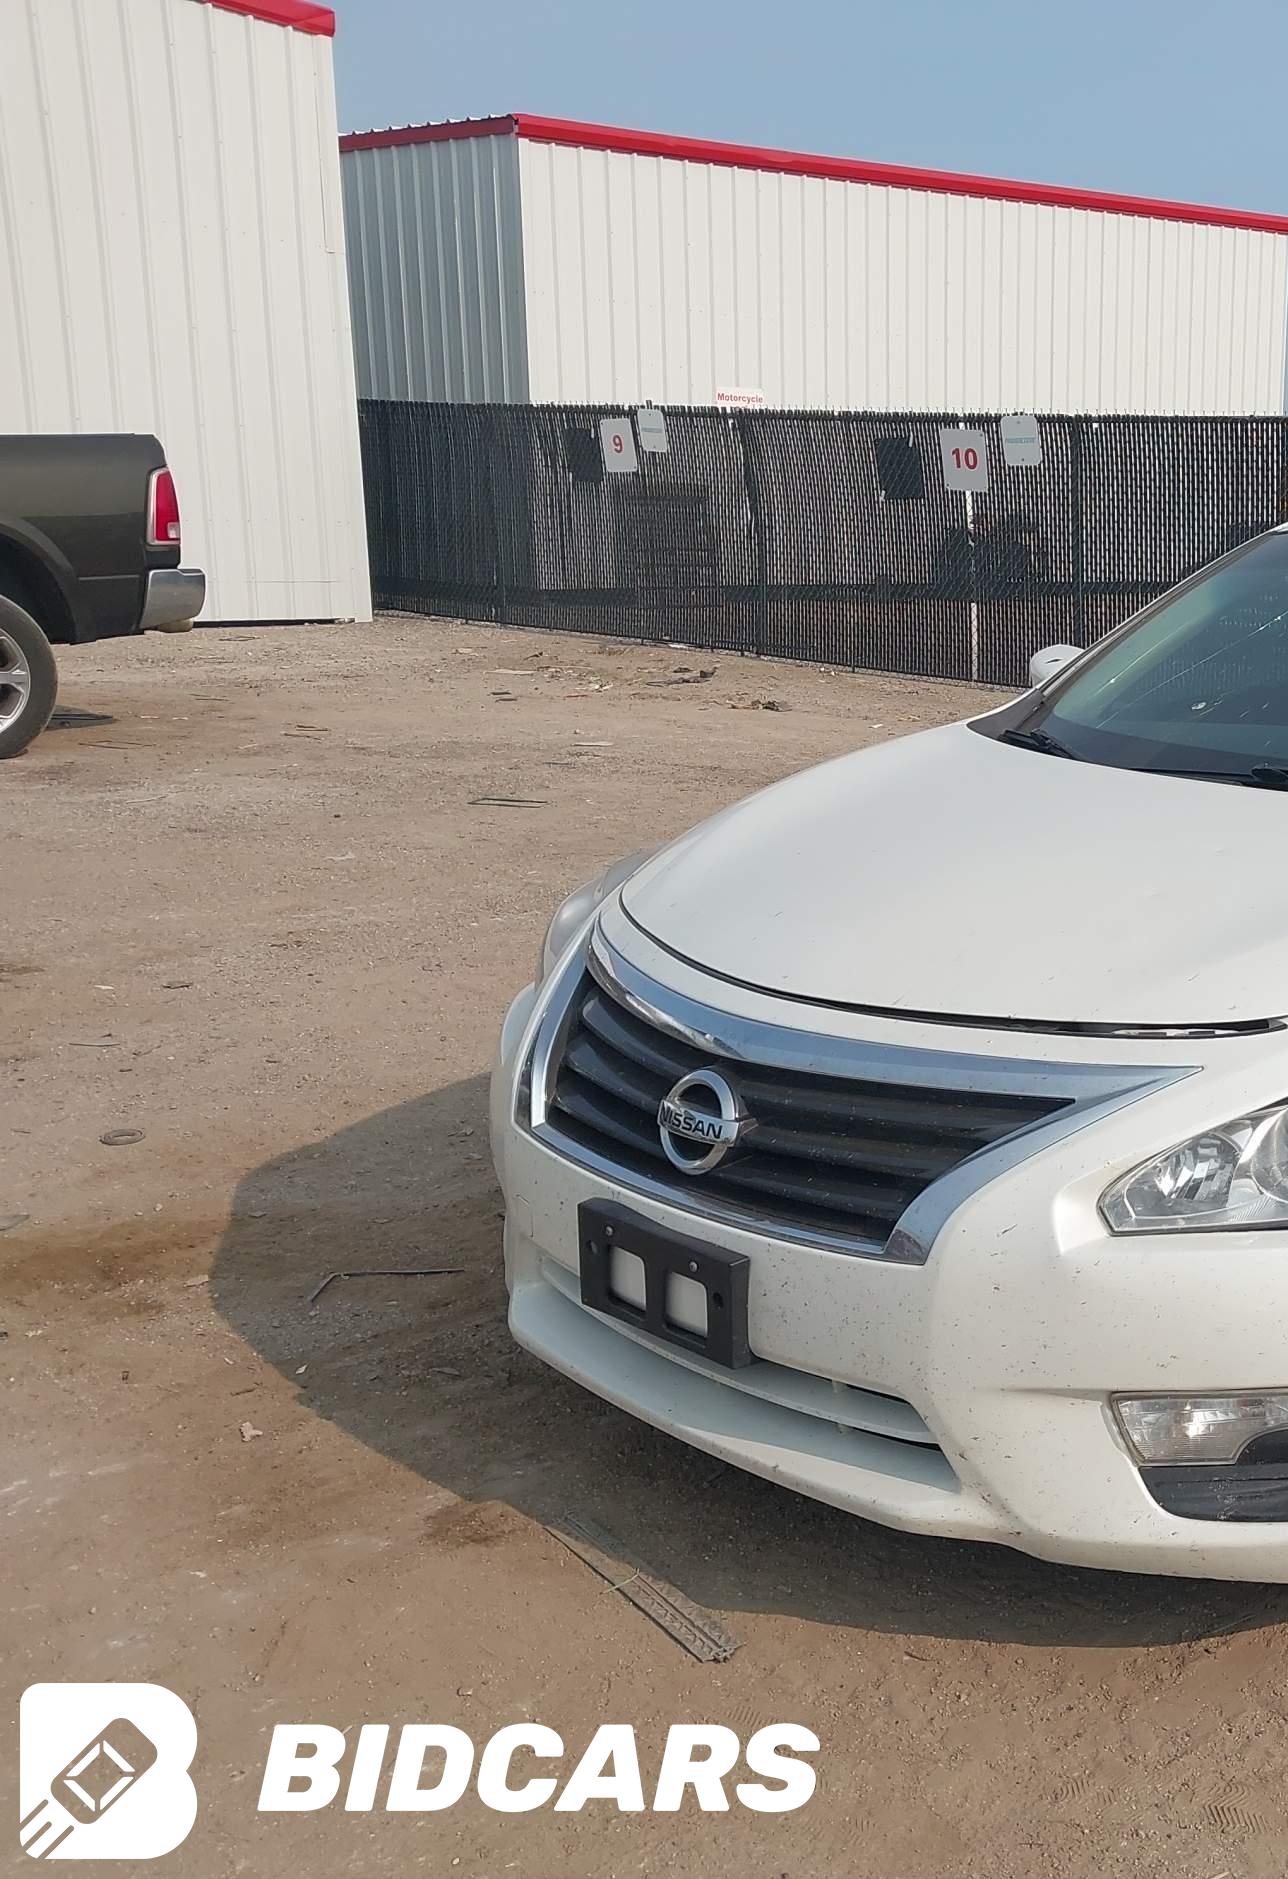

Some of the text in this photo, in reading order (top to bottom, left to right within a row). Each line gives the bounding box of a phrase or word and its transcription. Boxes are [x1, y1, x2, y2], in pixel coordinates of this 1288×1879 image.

[717, 392, 764, 405] Motorcycle
[612, 434, 624, 454] 9
[951, 447, 979, 470] 10
[660, 1102, 723, 1139] NISSAN
